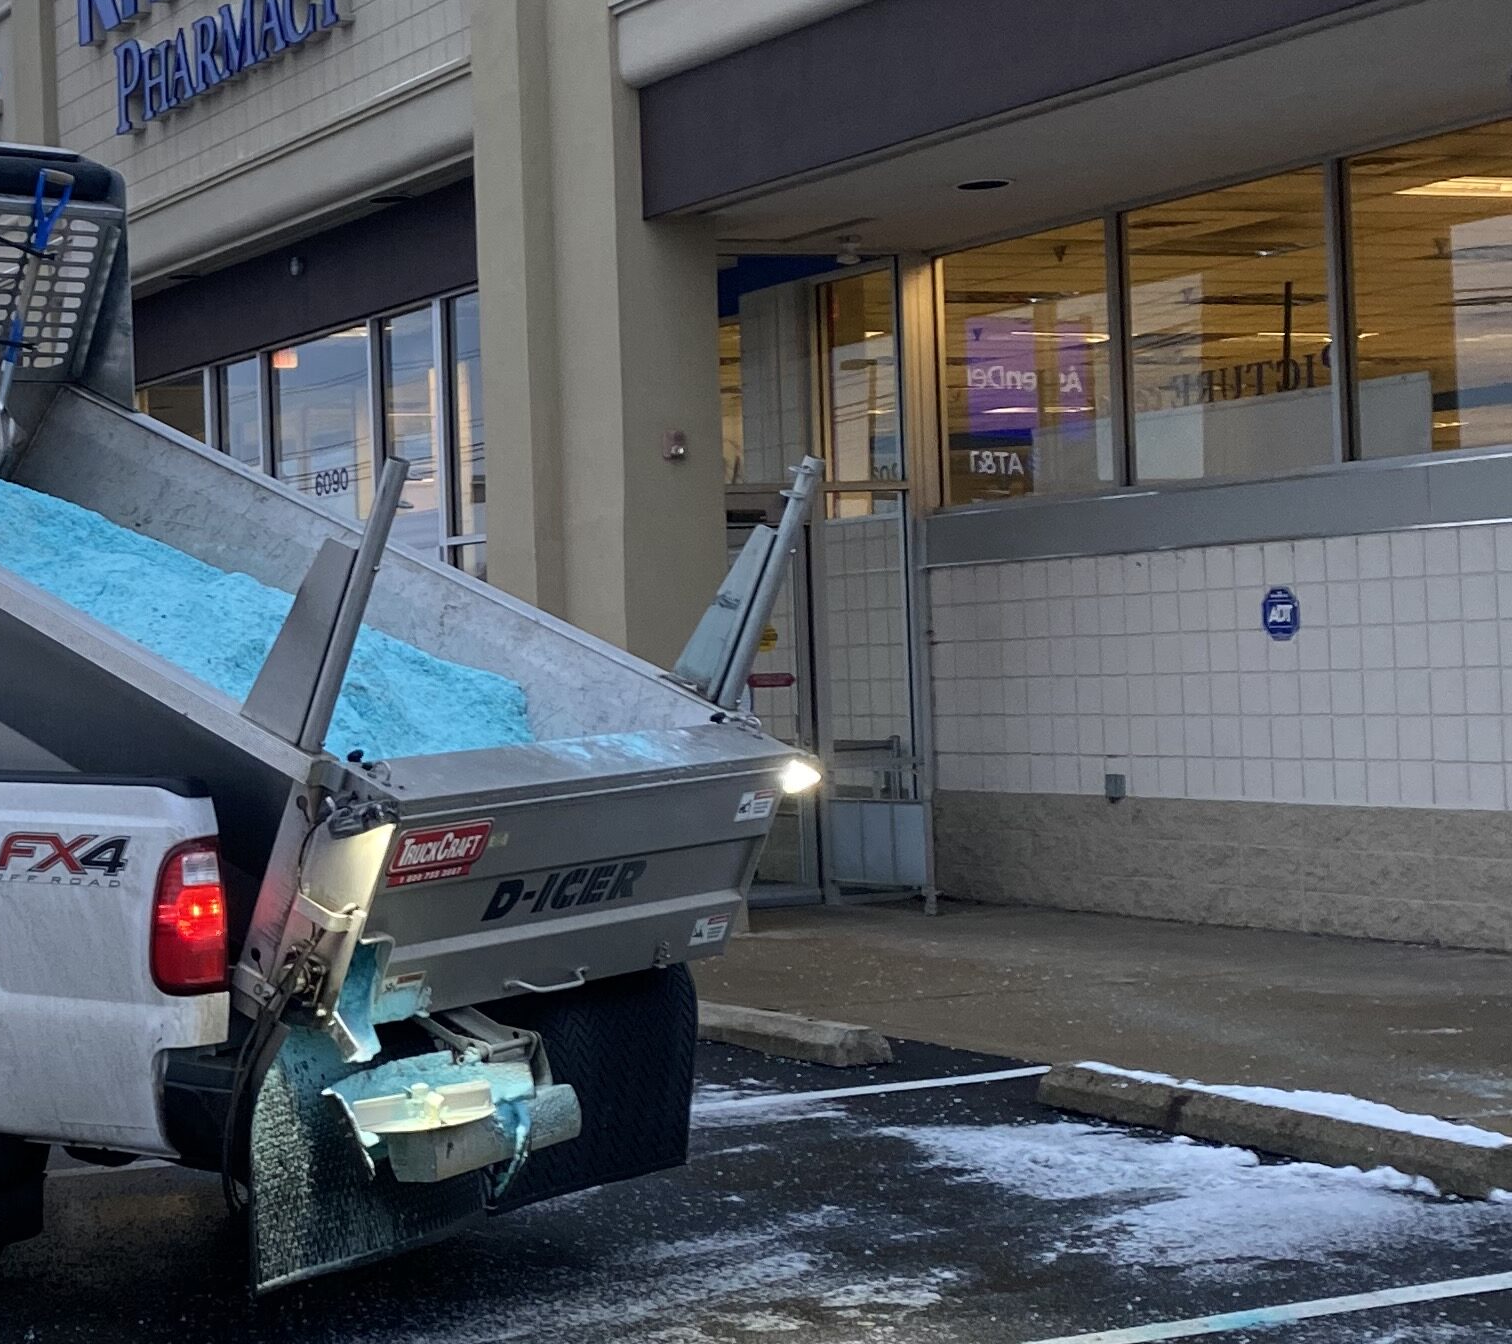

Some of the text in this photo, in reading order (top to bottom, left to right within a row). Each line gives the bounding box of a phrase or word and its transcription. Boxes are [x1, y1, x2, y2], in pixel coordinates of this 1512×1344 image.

[316, 467, 348, 496] 6090
[1269, 606, 1293, 623] ADT
[51, 876, 121, 888] ROAD
[480, 860, 648, 921] D-ICER
